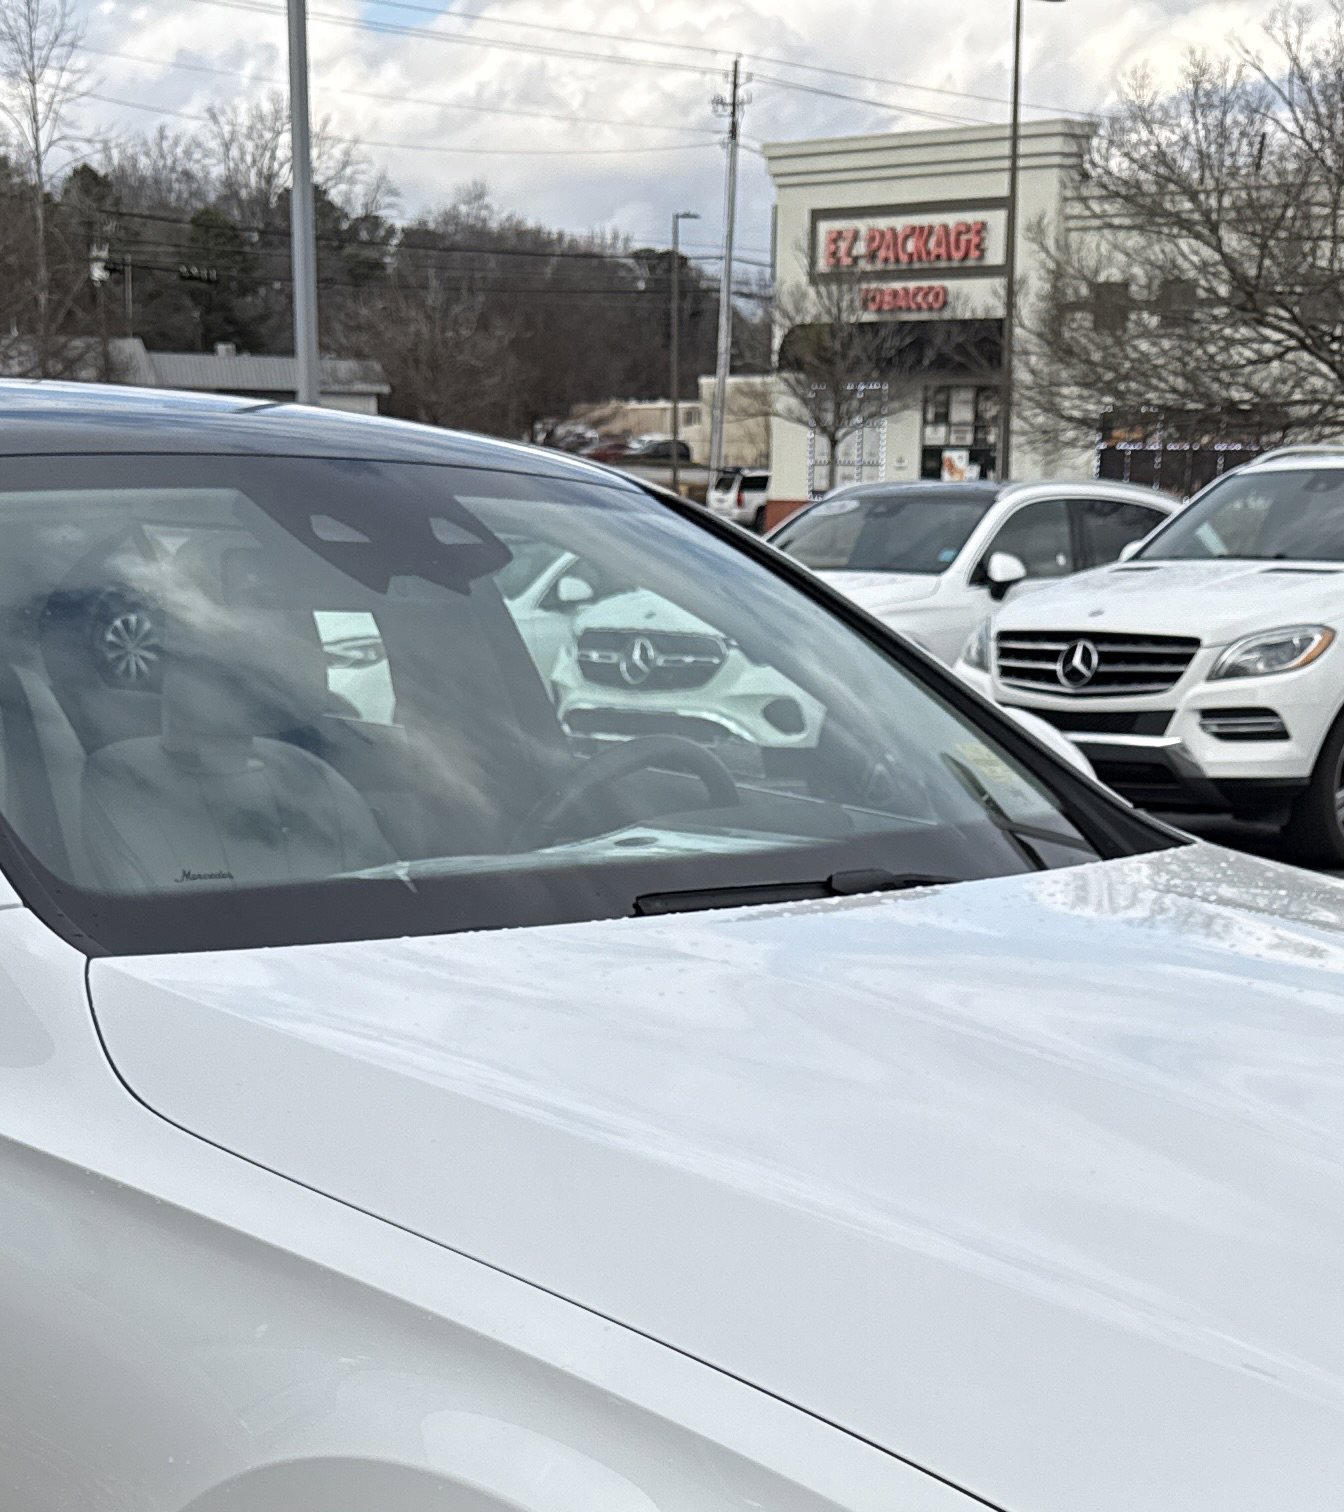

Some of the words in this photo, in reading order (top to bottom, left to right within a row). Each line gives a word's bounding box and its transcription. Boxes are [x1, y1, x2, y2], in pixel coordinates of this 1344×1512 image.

[824, 228, 857, 267] EZ
[864, 221, 987, 265] PACKAGE
[860, 285, 947, 312] TOBACCO
